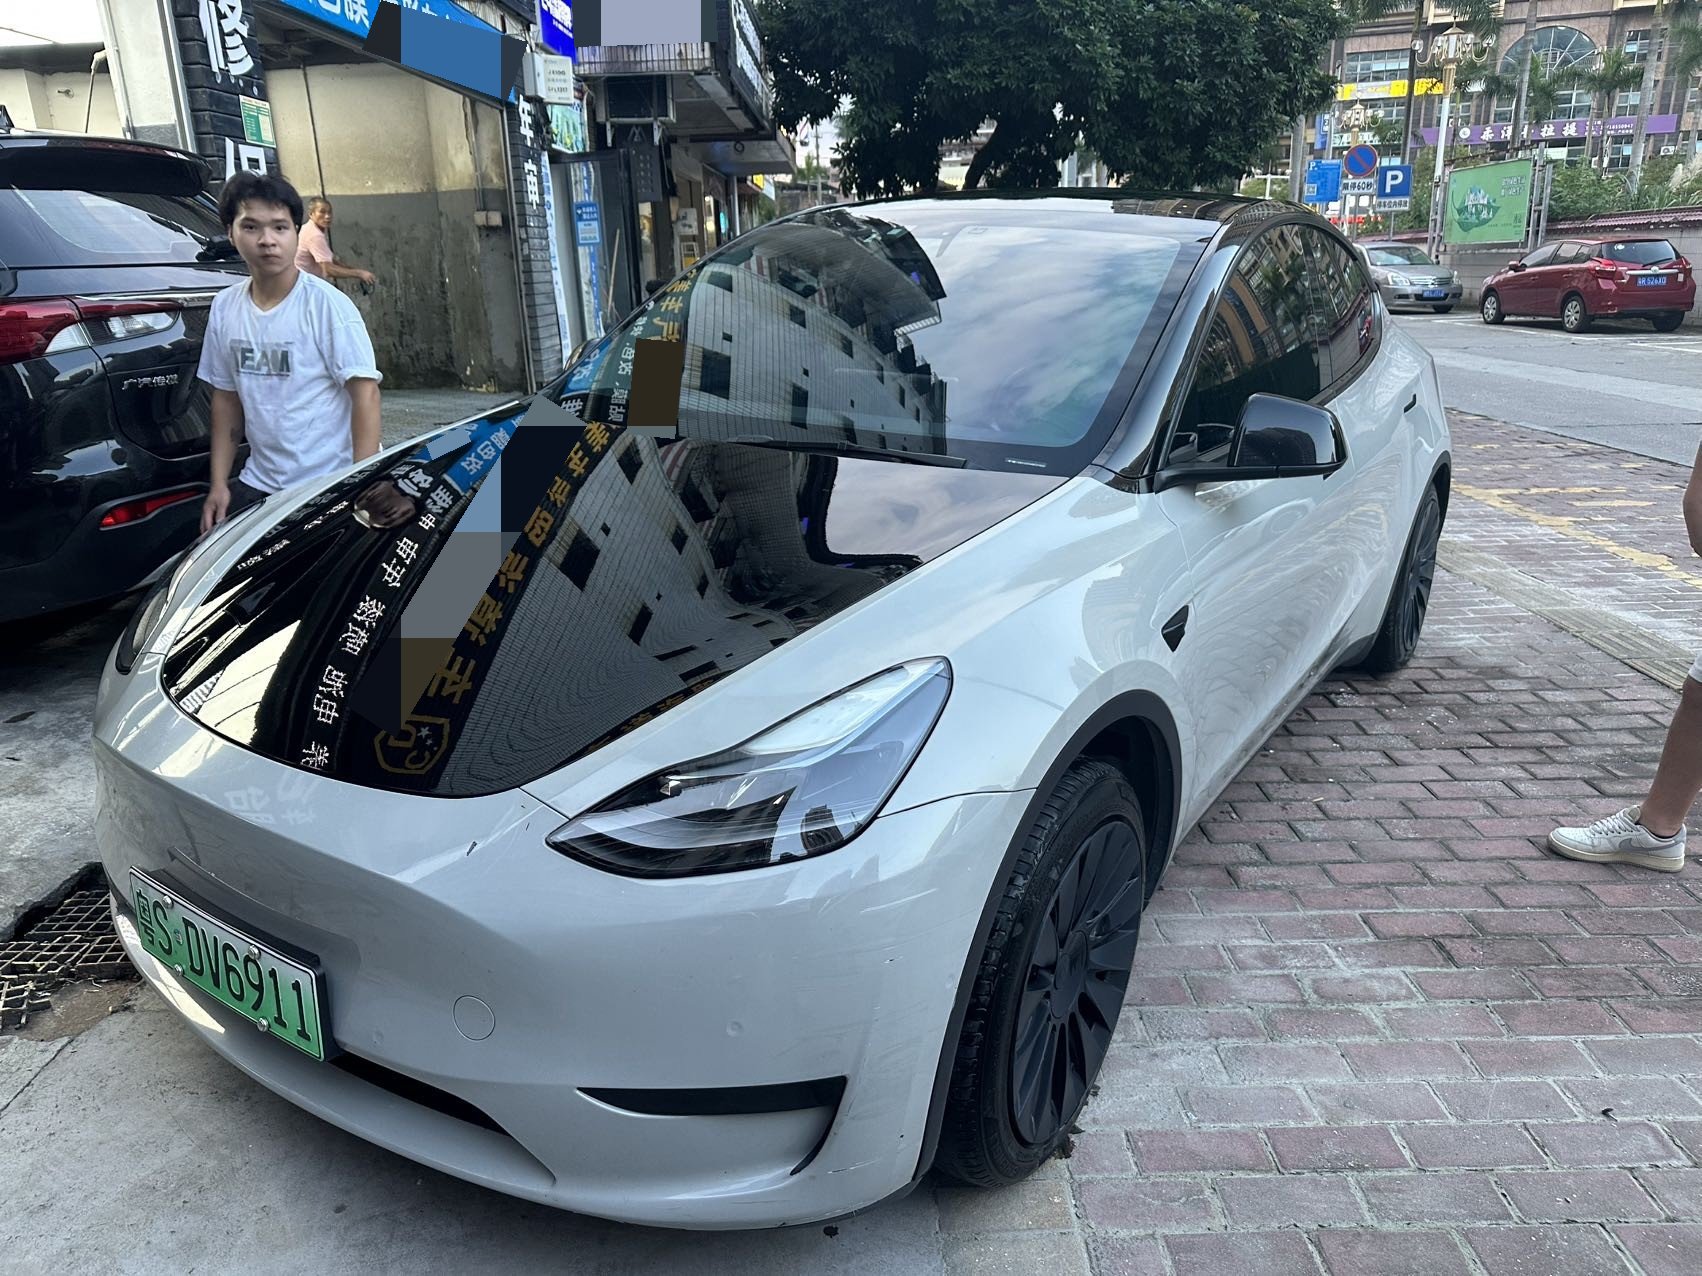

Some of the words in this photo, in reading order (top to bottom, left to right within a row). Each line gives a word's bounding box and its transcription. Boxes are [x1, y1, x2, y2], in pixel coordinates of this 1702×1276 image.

[1342, 181, 1373, 192] 限停60秒
[1385, 170, 1404, 193] P
